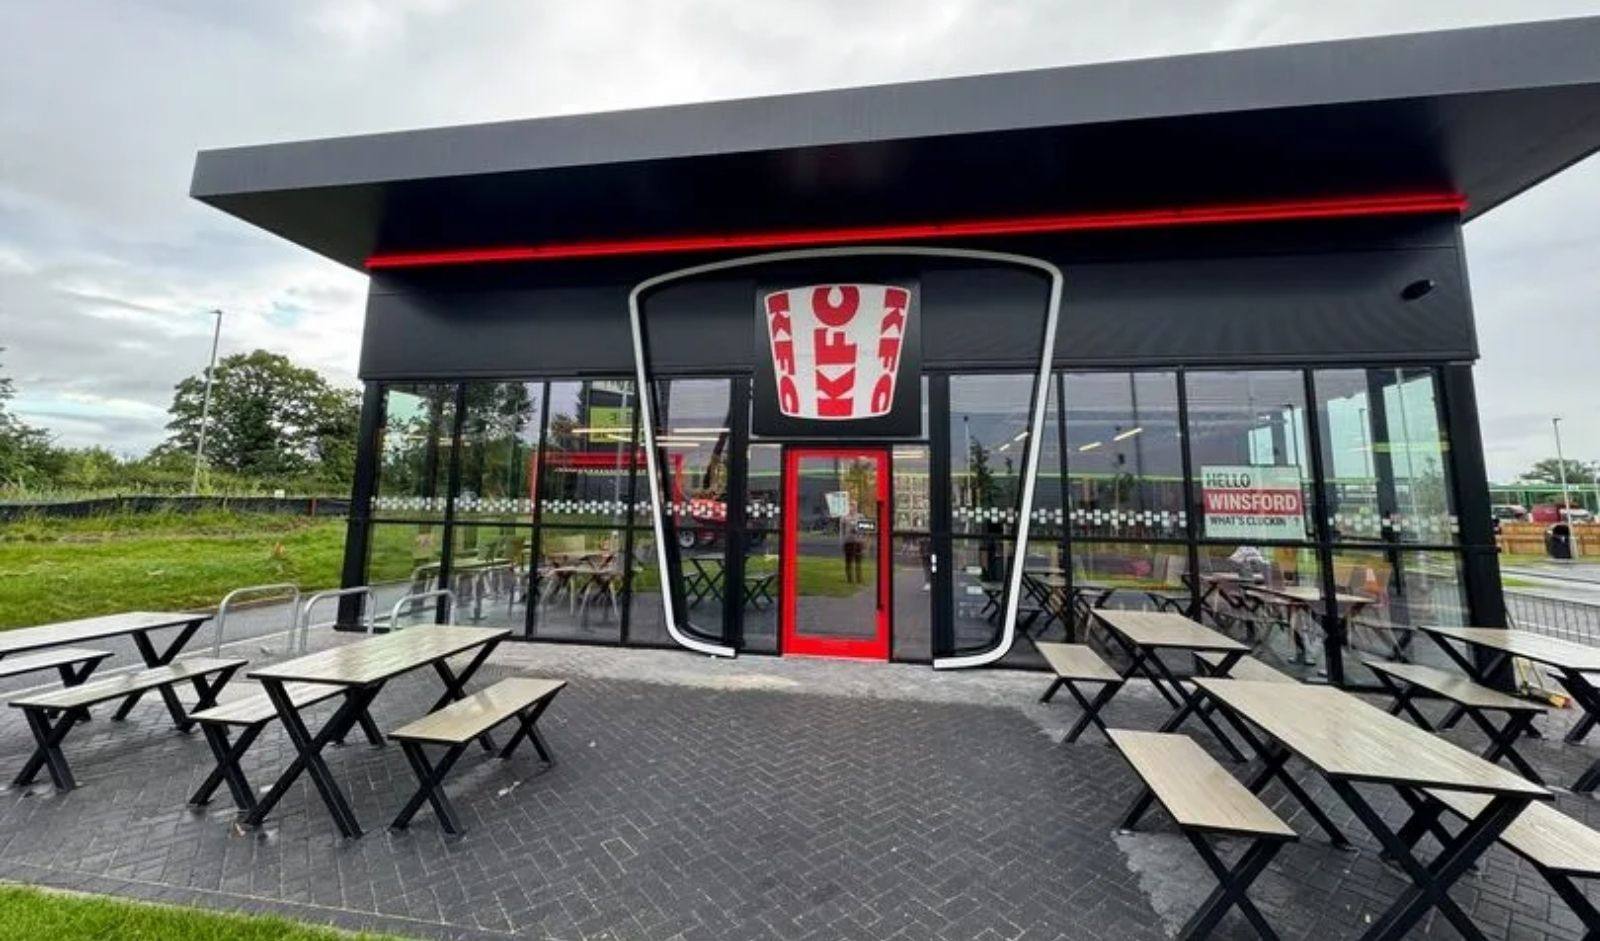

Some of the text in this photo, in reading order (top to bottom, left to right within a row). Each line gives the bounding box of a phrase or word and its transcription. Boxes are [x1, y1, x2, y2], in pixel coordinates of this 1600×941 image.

[768, 292, 799, 413] KFC
[812, 285, 859, 416] KFC
[871, 288, 907, 413] KFC
[1206, 473, 1250, 488] HELLO
[1208, 493, 1296, 511] WINSFORD
